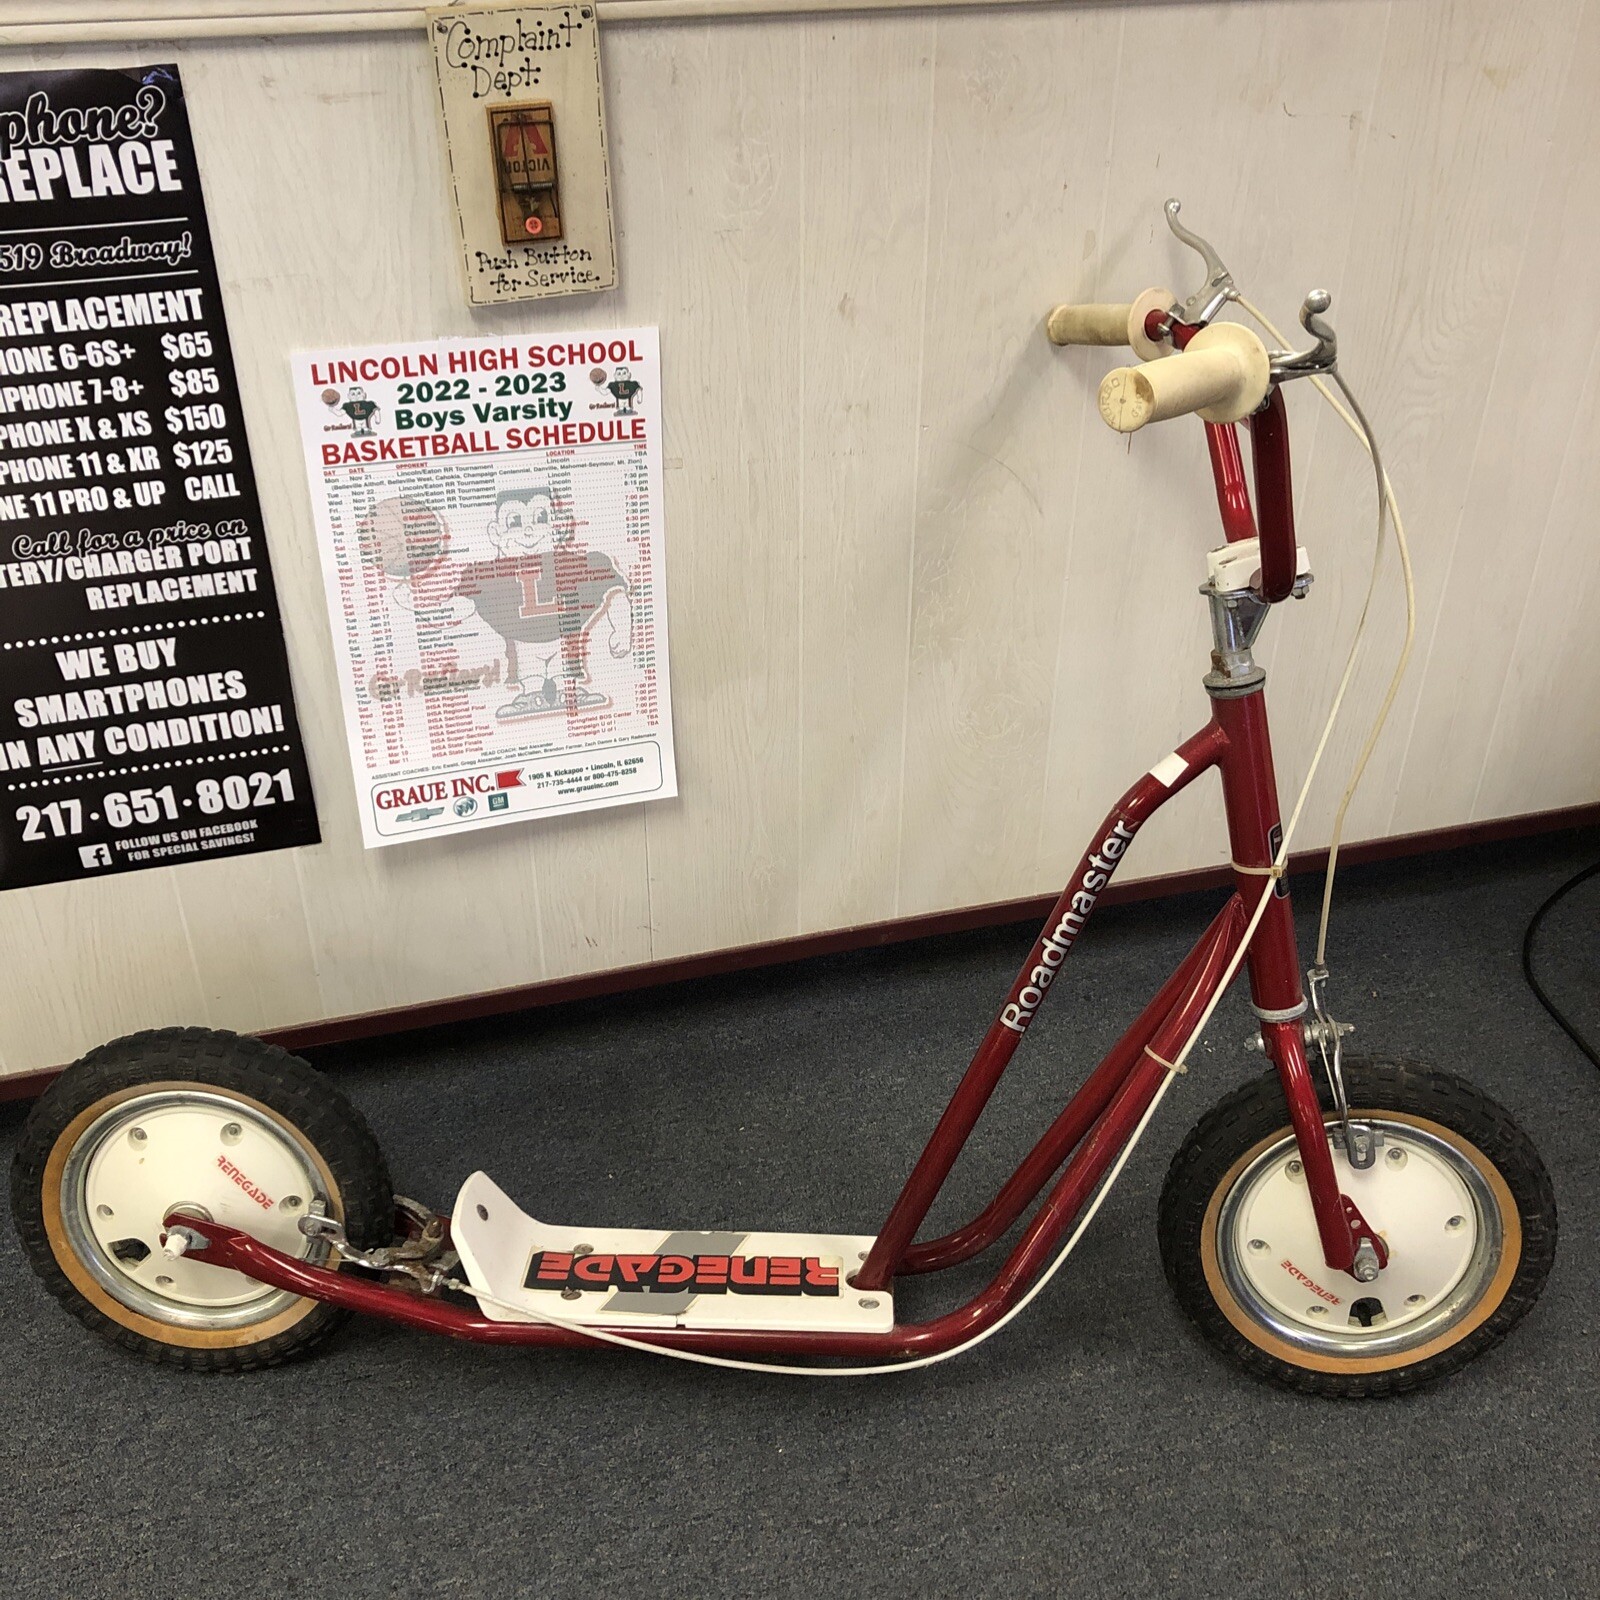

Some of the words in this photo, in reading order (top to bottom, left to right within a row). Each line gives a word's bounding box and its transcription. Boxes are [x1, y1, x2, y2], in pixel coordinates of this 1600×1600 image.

[446, 11, 583, 68] Complaint
[49, 230, 193, 268] Broadway!
[475, 250, 519, 272] Push
[523, 244, 593, 266] Button
[489, 272, 522, 293] for
[58, 339, 136, 370] 6-6S+
[160, 331, 213, 362] $65
[310, 353, 439, 386] LINCOLN
[449, 347, 519, 374] HIGH
[526, 340, 643, 367] SCHOOL
[87, 376, 144, 404] 7-8+
[168, 367, 220, 398] $85
[396, 378, 471, 405] 2022
[494, 371, 567, 398] 2023
[75, 416, 96, 442] X
[97, 418, 118, 440] &
[117, 410, 152, 437] XS
[164, 403, 227, 435] $150
[394, 408, 466, 432] Boys
[472, 397, 573, 423] Varsity
[76, 451, 103, 477] 11
[106, 453, 126, 475] &
[125, 446, 161, 472] XR
[172, 439, 233, 469] $125
[321, 431, 499, 466] BASKETBALL
[505, 418, 647, 450] SCHEDULE
[456, 463, 494, 472] Tournament
[457, 478, 495, 486] Tournament
[29, 491, 57, 517] 11
[58, 486, 109, 515] PRO
[112, 487, 132, 509] &
[133, 480, 166, 507] UP
[184, 472, 241, 501] CALL
[12, 530, 73, 560] Call
[76, 528, 119, 559] for
[123, 530, 142, 548] a
[148, 520, 211, 550] price
[215, 518, 248, 537] on
[187, 536, 251, 567] PORT
[85, 568, 258, 611] REPLACEMENT
[55, 646, 110, 681] WE
[113, 637, 176, 674] BUY
[13, 669, 247, 728] SMARTPHONES
[0, 740, 31, 772] IN
[37, 729, 96, 766] ANY
[103, 704, 285, 755] CONDITION!
[528, 773, 544, 781] 1905
[554, 767, 584, 777] Kickapoo
[590, 762, 616, 771] Lincoln,
[624, 756, 644, 766] 62656
[536, 776, 582, 789] 217-735-4444
[592, 767, 637, 780] 800-475-8258
[376, 781, 448, 810] GRAUE
[450, 774, 496, 798] INC.
[115, 834, 161, 851] FOLLOW
[162, 832, 179, 842] US
[181, 830, 197, 841] ON
[199, 819, 258, 838] FACEBOOK
[127, 851, 150, 862] FOR
[152, 841, 199, 858] SPECIAL
[200, 832, 255, 850] SAVINGS!
[999, 819, 1135, 1034] Roadmaster
[216, 1154, 275, 1211] RENEGADE
[525, 1251, 840, 1295] RENEGADE
[1280, 1260, 1345, 1306] RENEGADE
